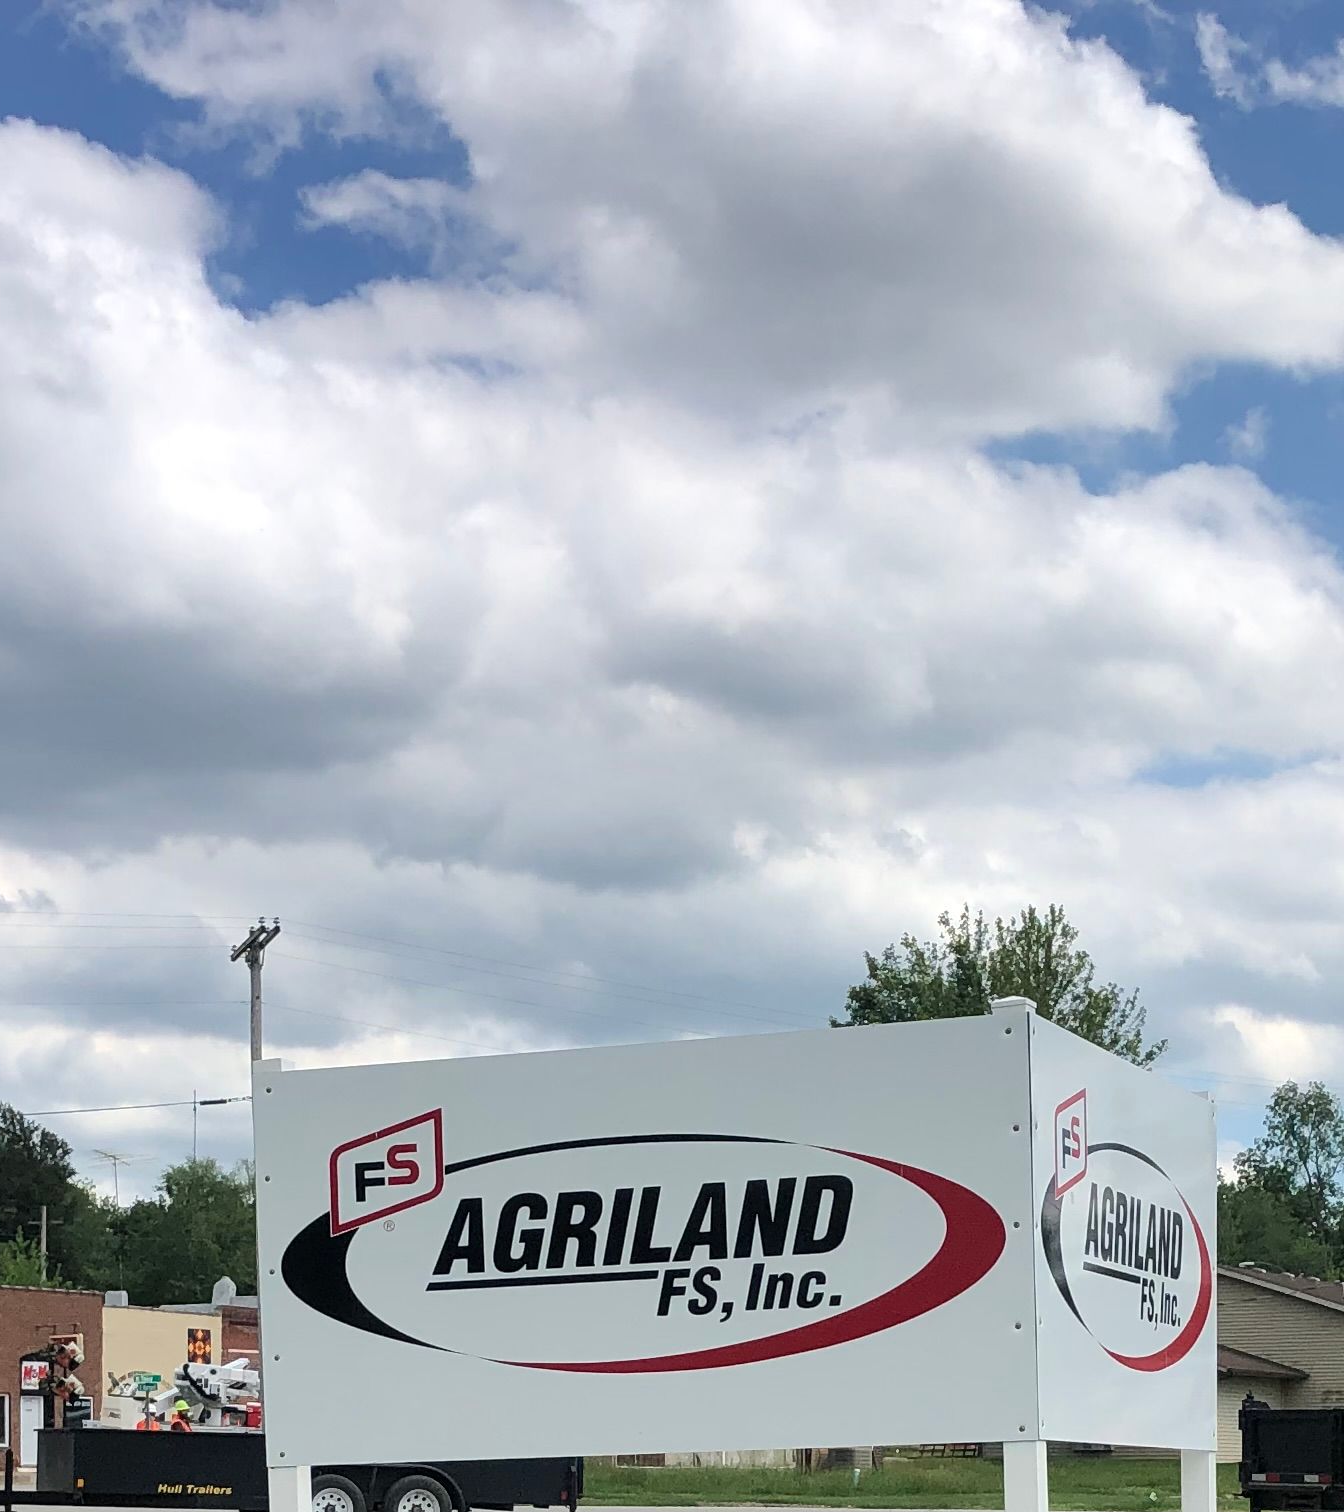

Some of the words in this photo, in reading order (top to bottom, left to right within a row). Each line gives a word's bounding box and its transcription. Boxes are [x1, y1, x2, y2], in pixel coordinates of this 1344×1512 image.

[1062, 1116, 1081, 1169] FS
[354, 1143, 419, 1203] FS
[432, 1174, 854, 1276] AGRILAND
[1085, 1182, 1183, 1280] AGRILAND
[657, 1265, 734, 1323] FS,
[745, 1262, 842, 1311] Inc.
[1141, 1277, 1158, 1331] FS,
[1160, 1282, 1181, 1327] Inc.
[158, 1483, 183, 1494] Hull
[186, 1484, 233, 1495] Trailers
